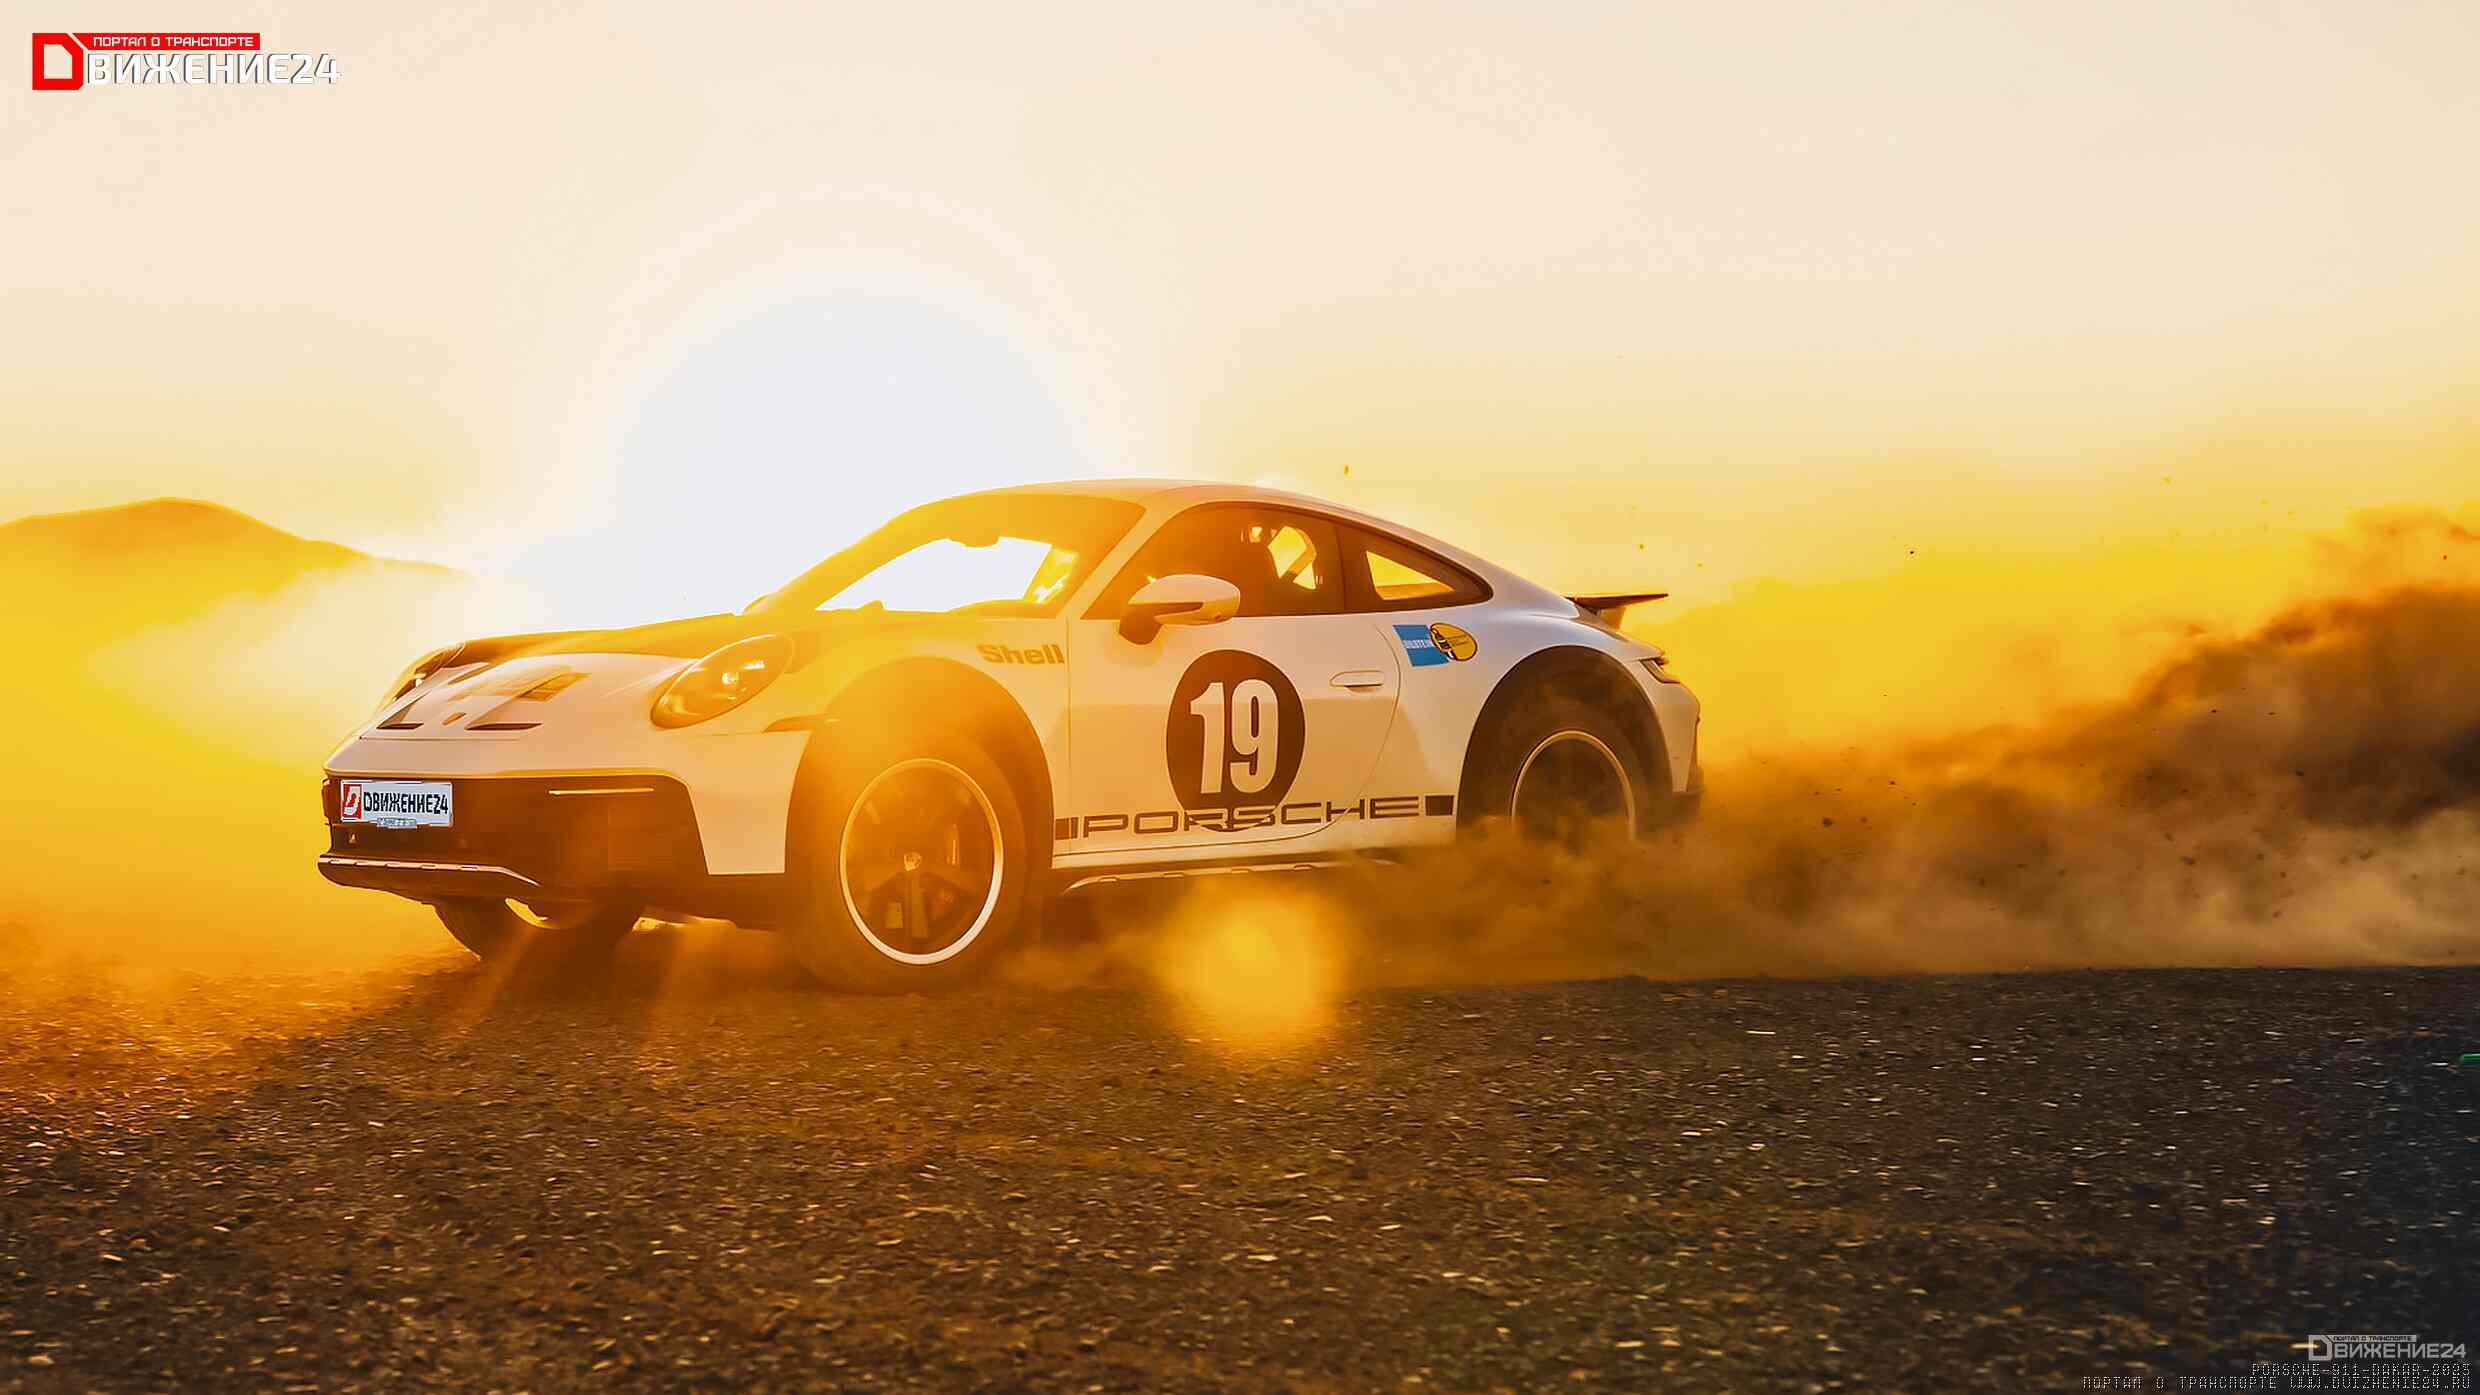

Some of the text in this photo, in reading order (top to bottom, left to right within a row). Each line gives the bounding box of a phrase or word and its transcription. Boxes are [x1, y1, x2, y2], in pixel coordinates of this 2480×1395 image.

[977, 644, 1065, 665] Shell
[1190, 679, 1279, 794] 19
[1082, 795, 1421, 838] PORSCHE
